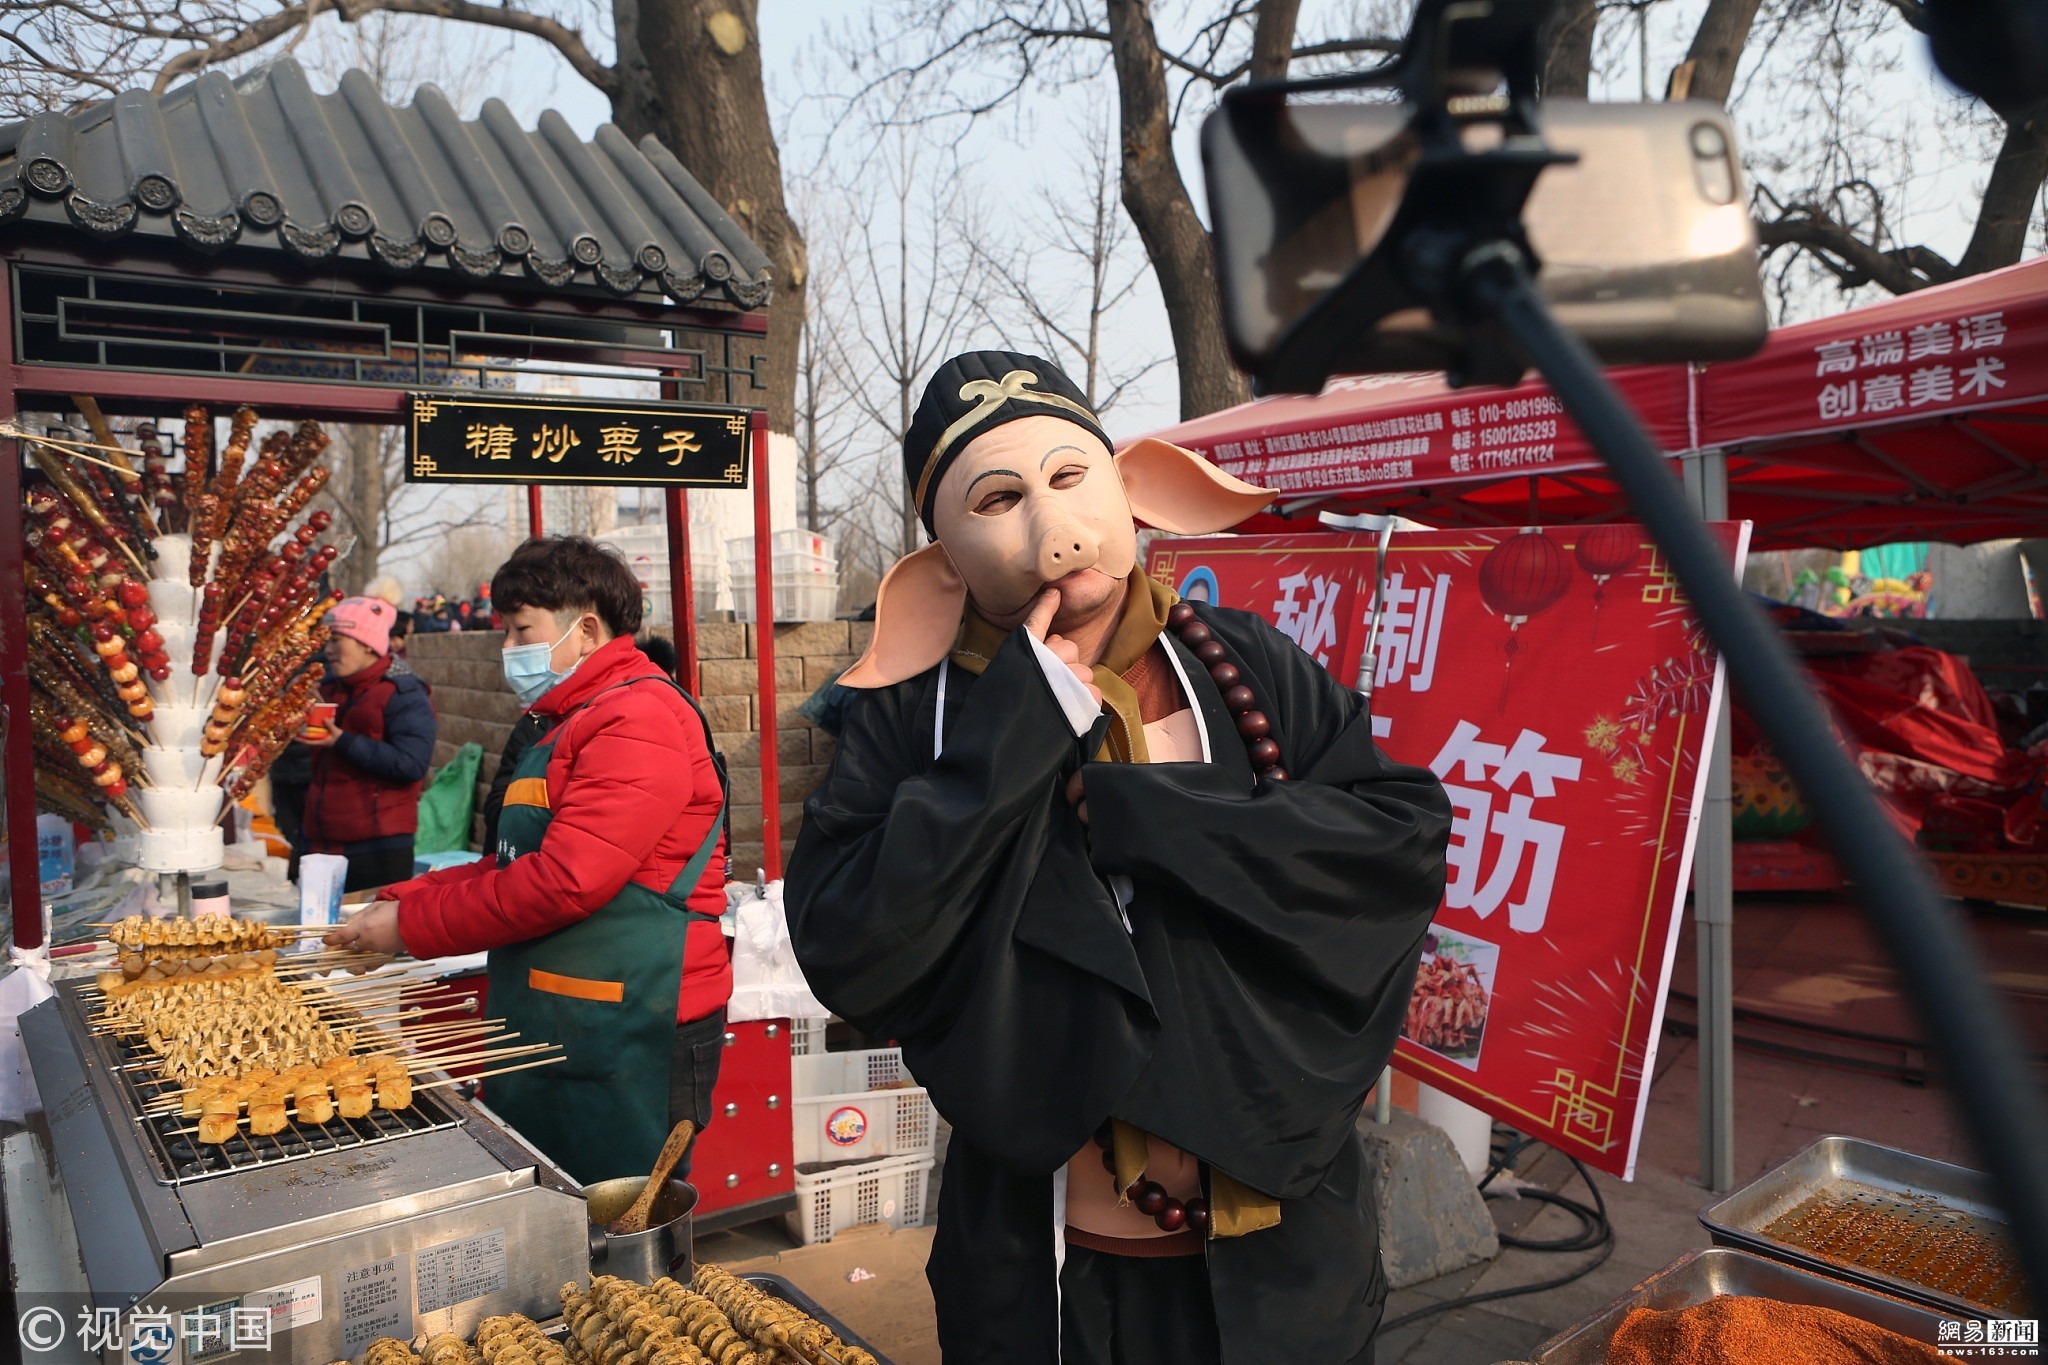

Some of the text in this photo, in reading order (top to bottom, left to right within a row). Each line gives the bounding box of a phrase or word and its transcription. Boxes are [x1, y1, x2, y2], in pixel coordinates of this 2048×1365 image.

[1814, 311, 2007, 378] 高端美语
[1816, 357, 2007, 420] 创意美术
[465, 422, 702, 466] 糖炒栗子
[347, 1260, 395, 1283] 注意事项
